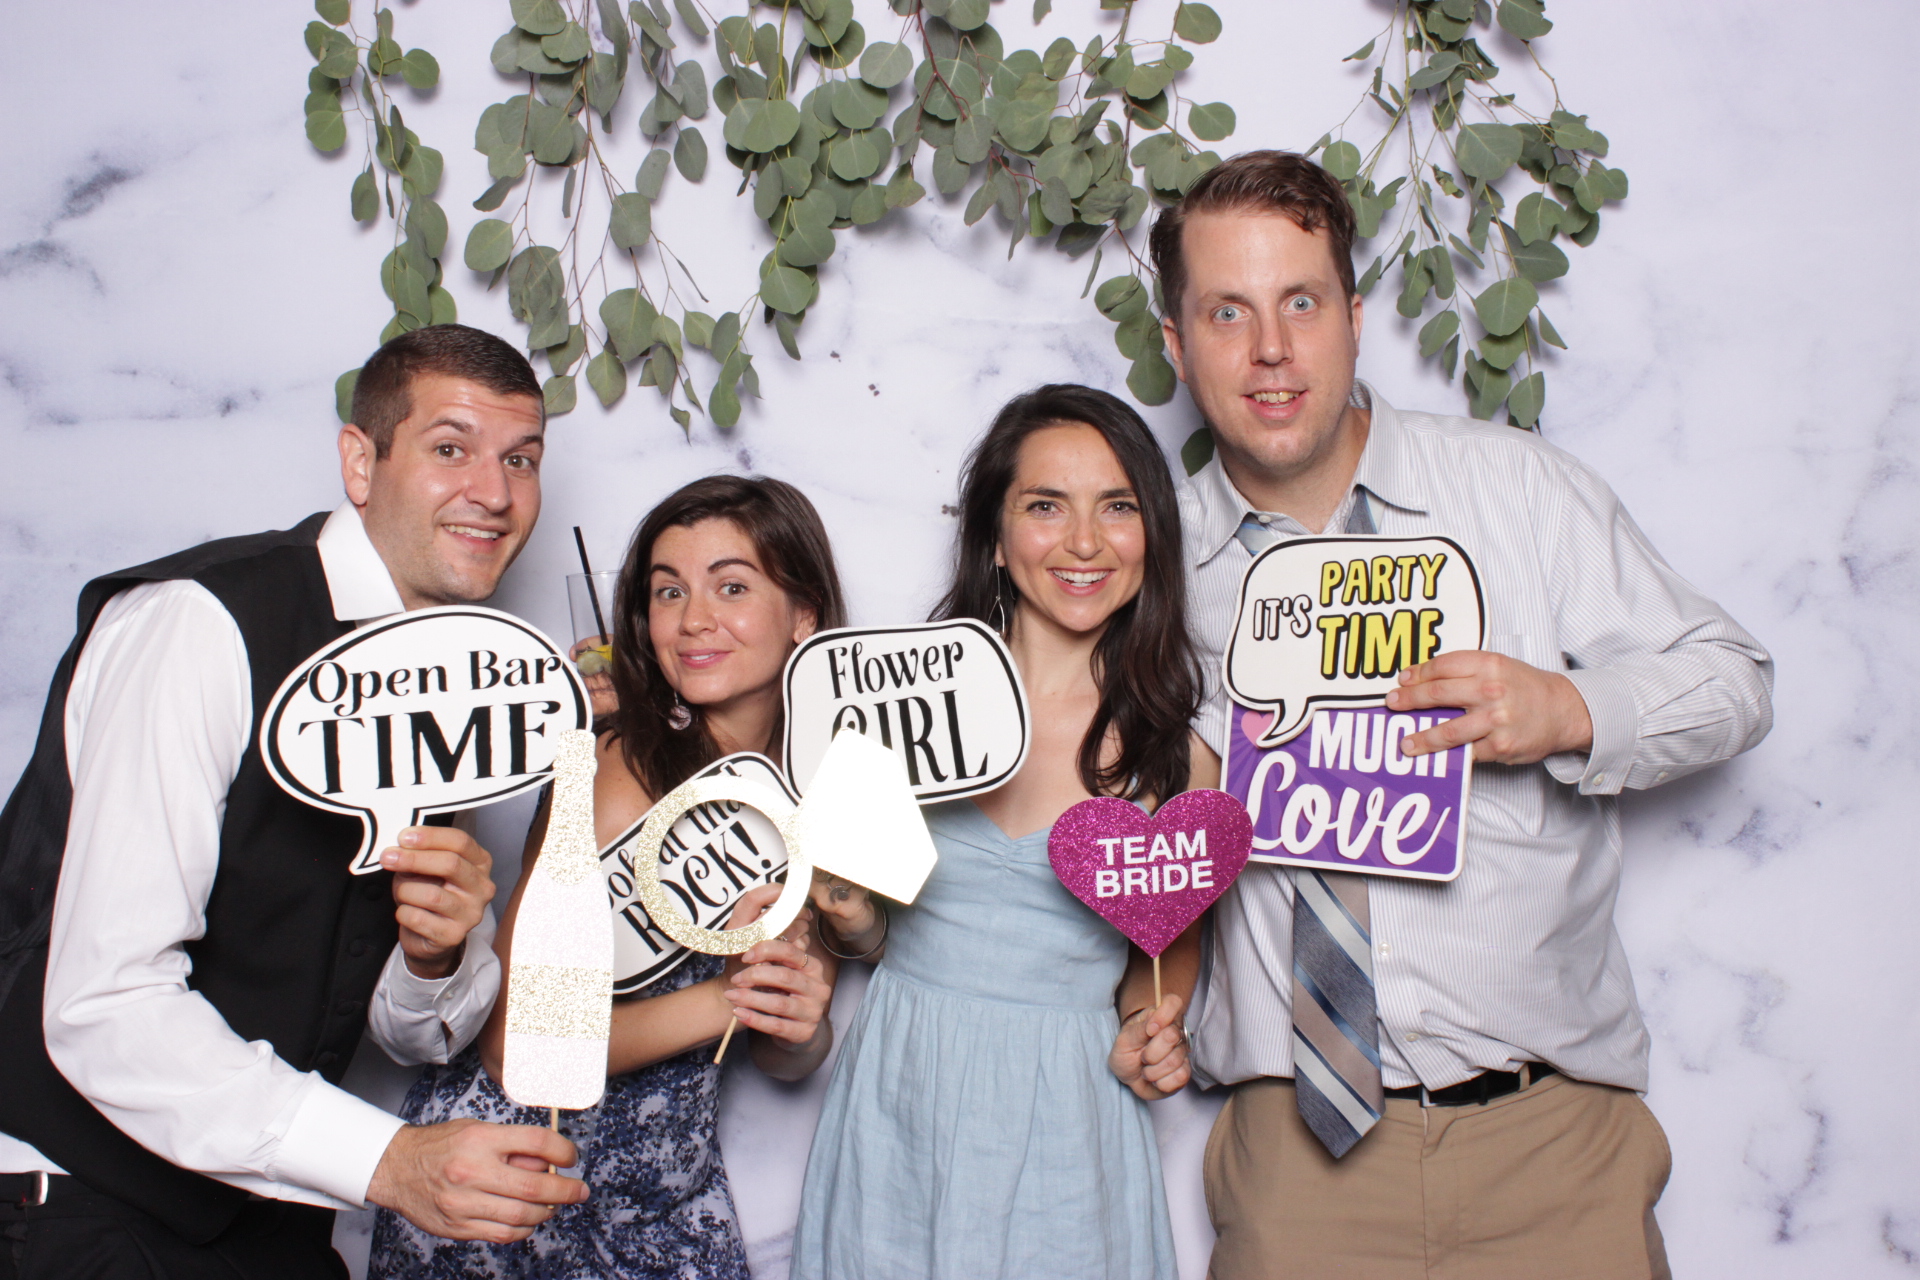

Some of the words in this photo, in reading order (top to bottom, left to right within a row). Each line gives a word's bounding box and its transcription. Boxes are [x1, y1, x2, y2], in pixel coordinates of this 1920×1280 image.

[1252, 594, 1313, 641] IT'S
[1319, 553, 1448, 607] PARTY
[826, 641, 964, 700] Flower
[1316, 608, 1444, 680] TIME
[308, 660, 448, 717] Open
[468, 649, 562, 690] Bar
[298, 700, 562, 795] TIME
[1309, 710, 1451, 778] MUCH
[1246, 750, 1452, 865] Love
[1095, 860, 1214, 898] BRIDE
[1096, 829, 1208, 866] TEAM
